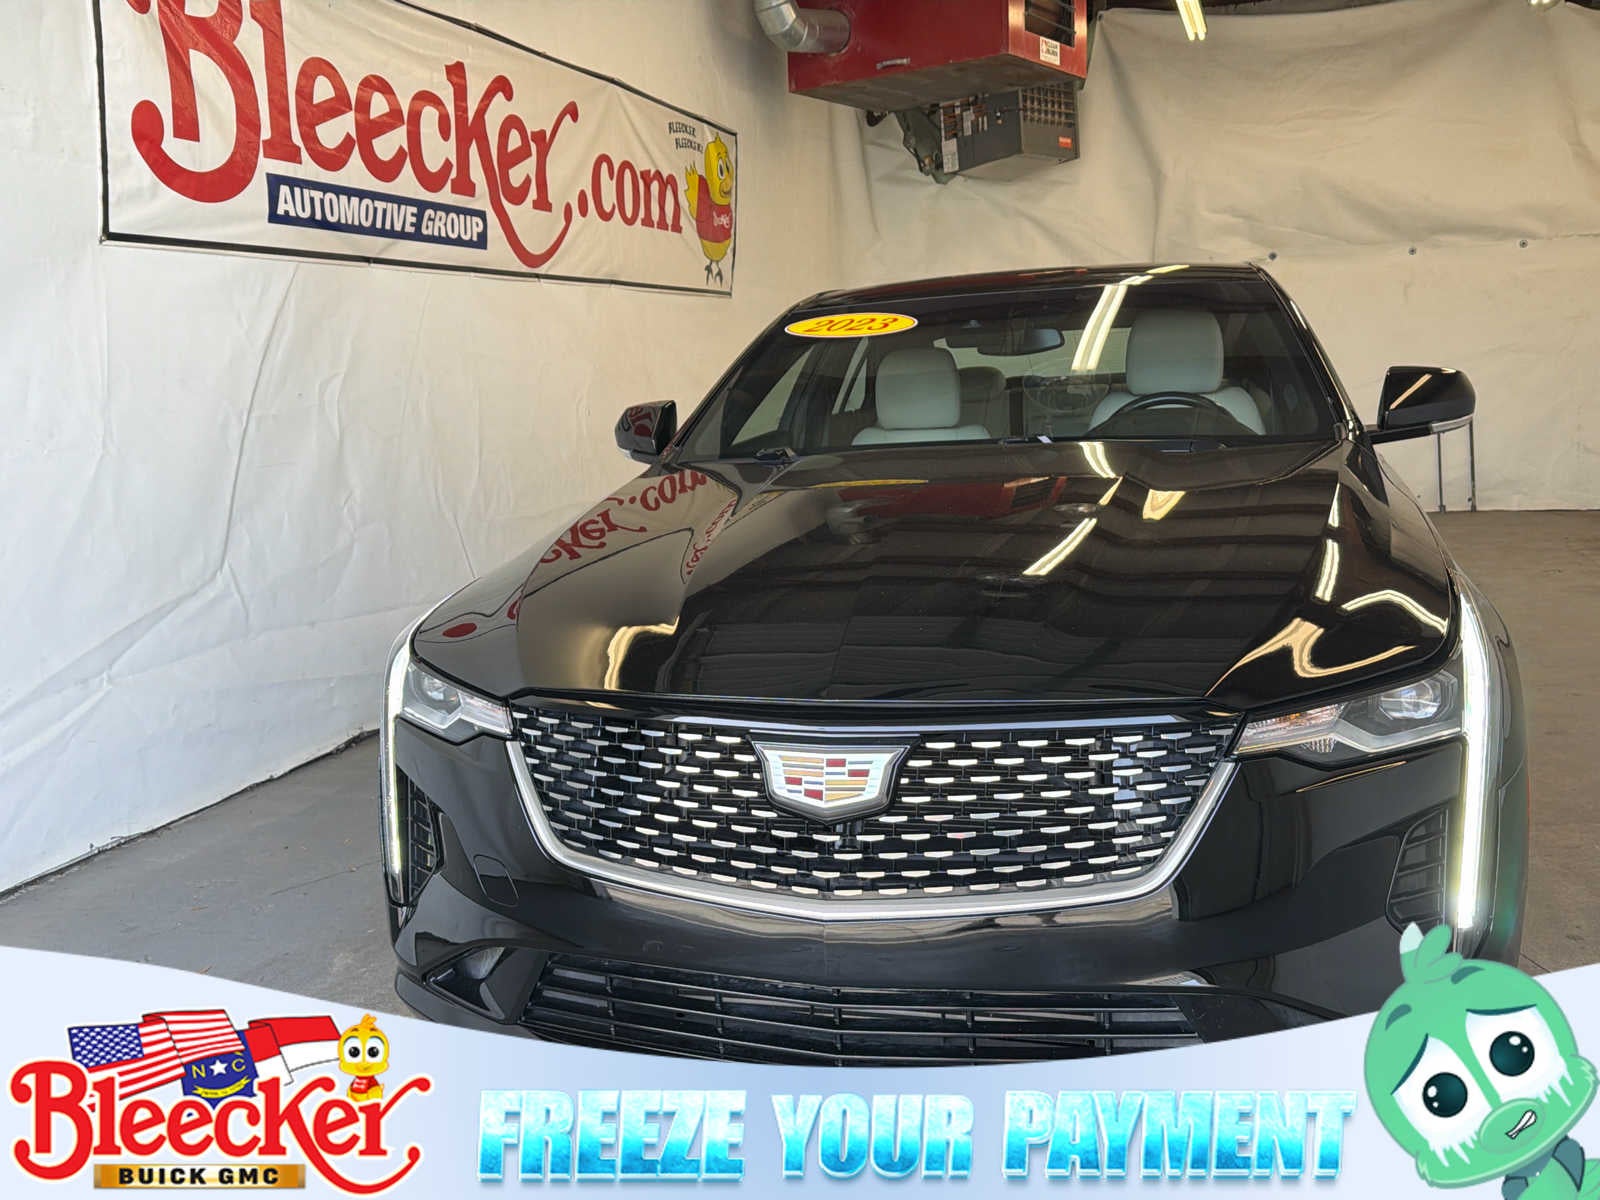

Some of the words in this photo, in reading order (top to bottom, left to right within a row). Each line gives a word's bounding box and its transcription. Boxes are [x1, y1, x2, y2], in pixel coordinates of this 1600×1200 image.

[276, 184, 418, 234] AUTOMOTIVE
[421, 208, 484, 242] GROUP
[803, 317, 898, 333] 2023
